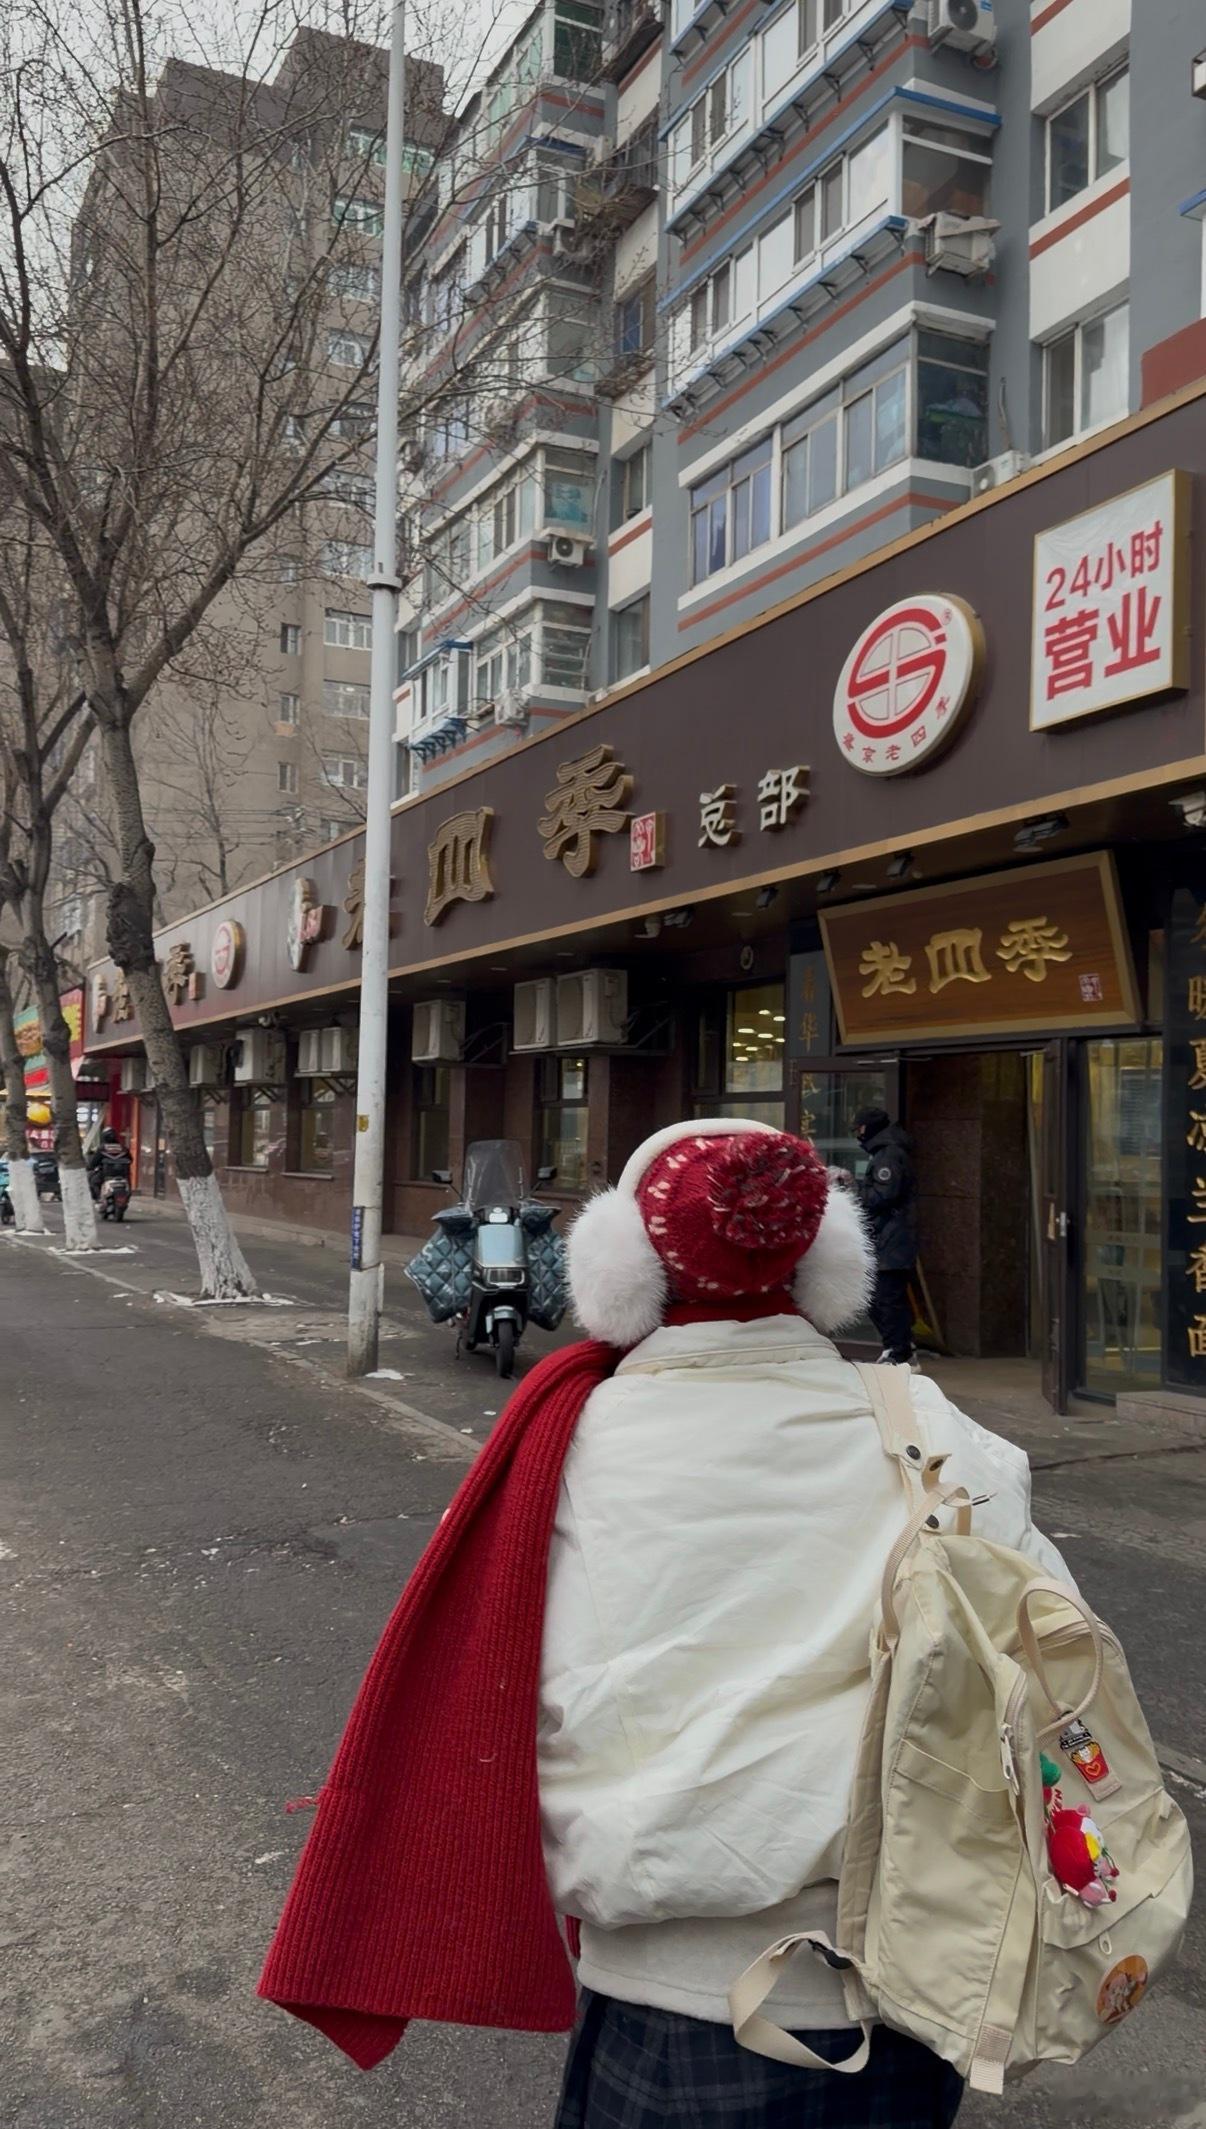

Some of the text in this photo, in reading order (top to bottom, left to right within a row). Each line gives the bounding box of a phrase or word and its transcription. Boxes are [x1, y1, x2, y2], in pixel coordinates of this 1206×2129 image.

[1045, 520, 1164, 612] 24小时
[1044, 586, 1161, 701] 营业
[698, 764, 810, 848] 总部
[858, 915, 1073, 998] 老四季
